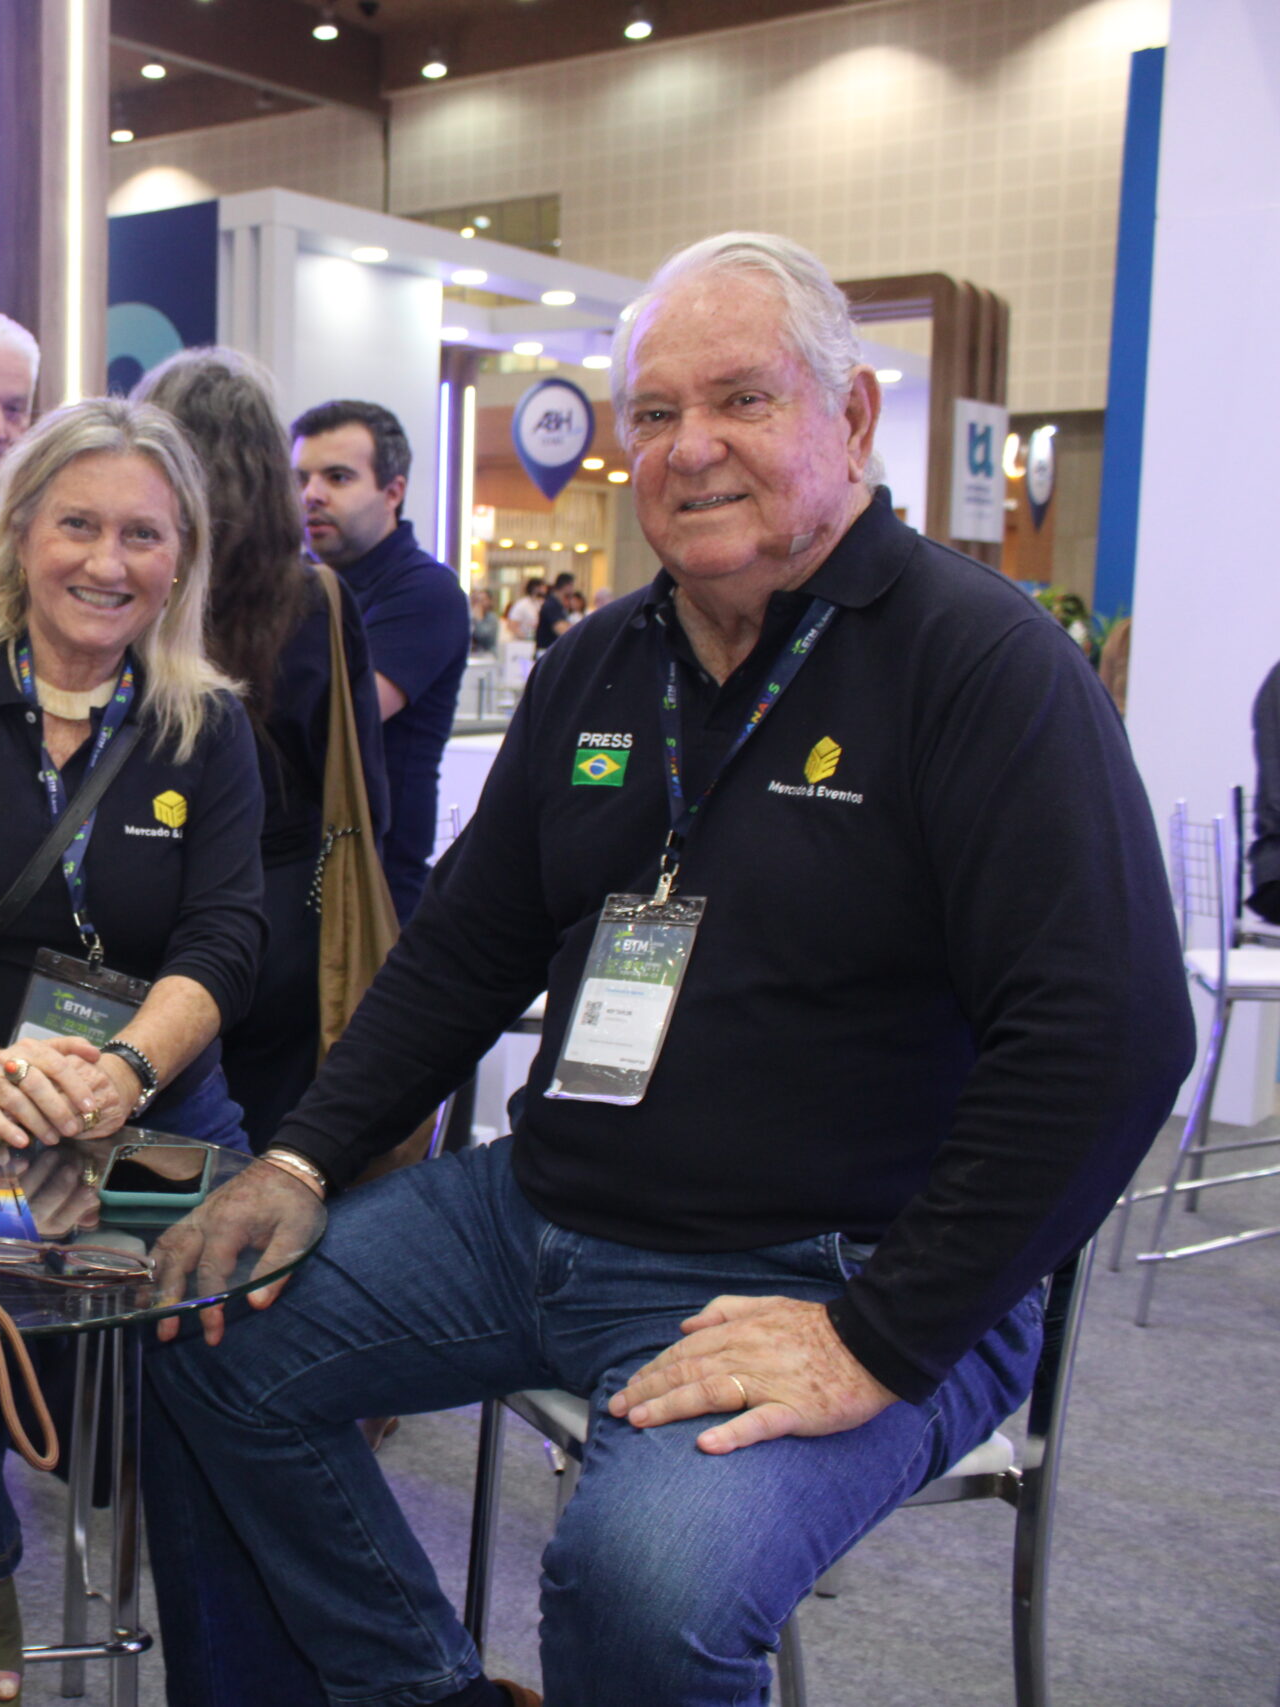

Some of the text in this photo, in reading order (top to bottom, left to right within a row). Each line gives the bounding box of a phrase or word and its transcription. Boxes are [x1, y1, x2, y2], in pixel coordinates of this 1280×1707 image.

[577, 732, 633, 748] PRESS
[816, 785, 863, 804] Eventos
[124, 824, 171, 837] Mercado
[623, 939, 649, 952] BTM
[63, 1000, 93, 1019] BTM
